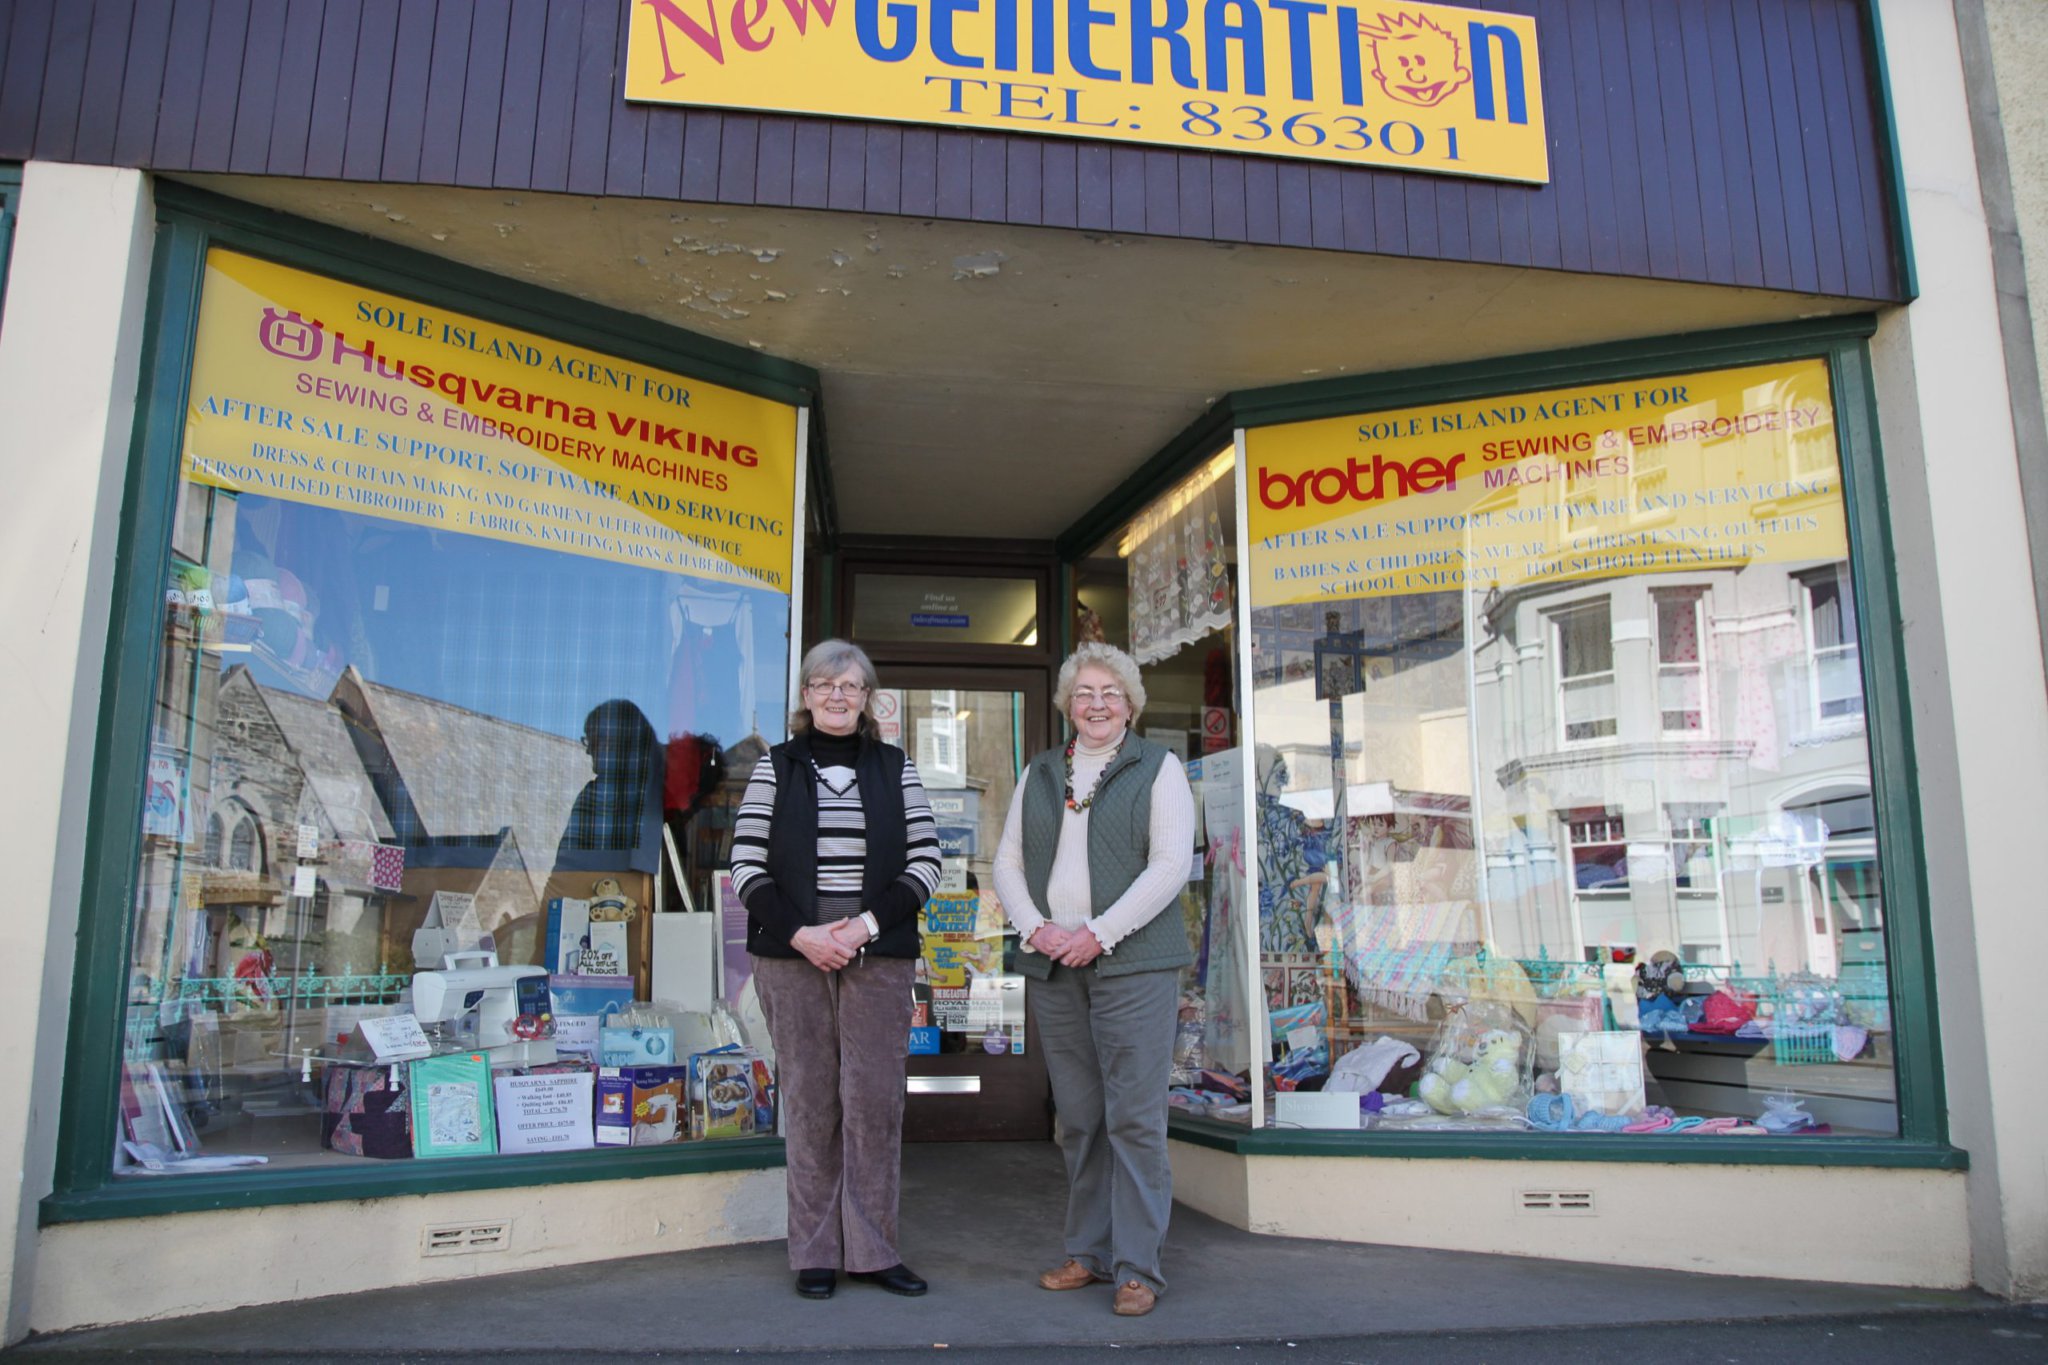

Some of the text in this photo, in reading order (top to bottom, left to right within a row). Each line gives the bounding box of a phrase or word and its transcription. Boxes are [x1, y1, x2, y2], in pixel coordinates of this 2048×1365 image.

[924, 75, 1466, 162] TEL: 836301
[356, 300, 691, 408] SOLE ISLAND AGENT FOR
[332, 331, 758, 468] Husqvarna VIKING
[1358, 386, 1690, 443] SOLE ISLAND AGENT FOR
[296, 372, 728, 492] SEWING & EMBROIDERY MACHINES
[1481, 406, 1821, 462] SEWING & EMBROIDERY
[200, 395, 783, 538] AFTER SALE SUPPORT, SOFTWARE AND SERVICING
[1258, 453, 1466, 510] brother
[1483, 455, 1630, 489] MACHINES
[191, 456, 331, 498] PERSONALISED
[335, 481, 448, 520] EMBROIDERY
[468, 510, 538, 539] FABRICS,
[541, 527, 613, 552] KNITTING
[617, 540, 661, 561] YARNS
[664, 550, 675, 565] &
[679, 553, 784, 586] HABERDASHERY
[252, 442, 743, 556] DRESS & CURTAIN MAKING AND GARMENT ALTERATION SERVICE
[1259, 478, 1830, 551] AFTER SALE SUPPORT, SOFTWARE AND SERVICING
[1273, 561, 1341, 582] BABIES
[1346, 559, 1360, 574] &
[1365, 547, 1481, 572] CHILDRENS
[1485, 541, 1544, 559] WEAR
[1572, 522, 1718, 552] CHRISTENING
[1319, 576, 1400, 597] SCHOOL
[1405, 566, 1500, 590] UNIFORM
[1525, 549, 1655, 577] HOUSEHOLD
[1664, 541, 1767, 566] TEXTILES
[925, 897, 980, 915] CIRCUS
[581, 950, 613, 960] 20% OFF
[586, 967, 618, 975] PRODUCTS
[509, 1080, 546, 1089] HUSQVARNA
